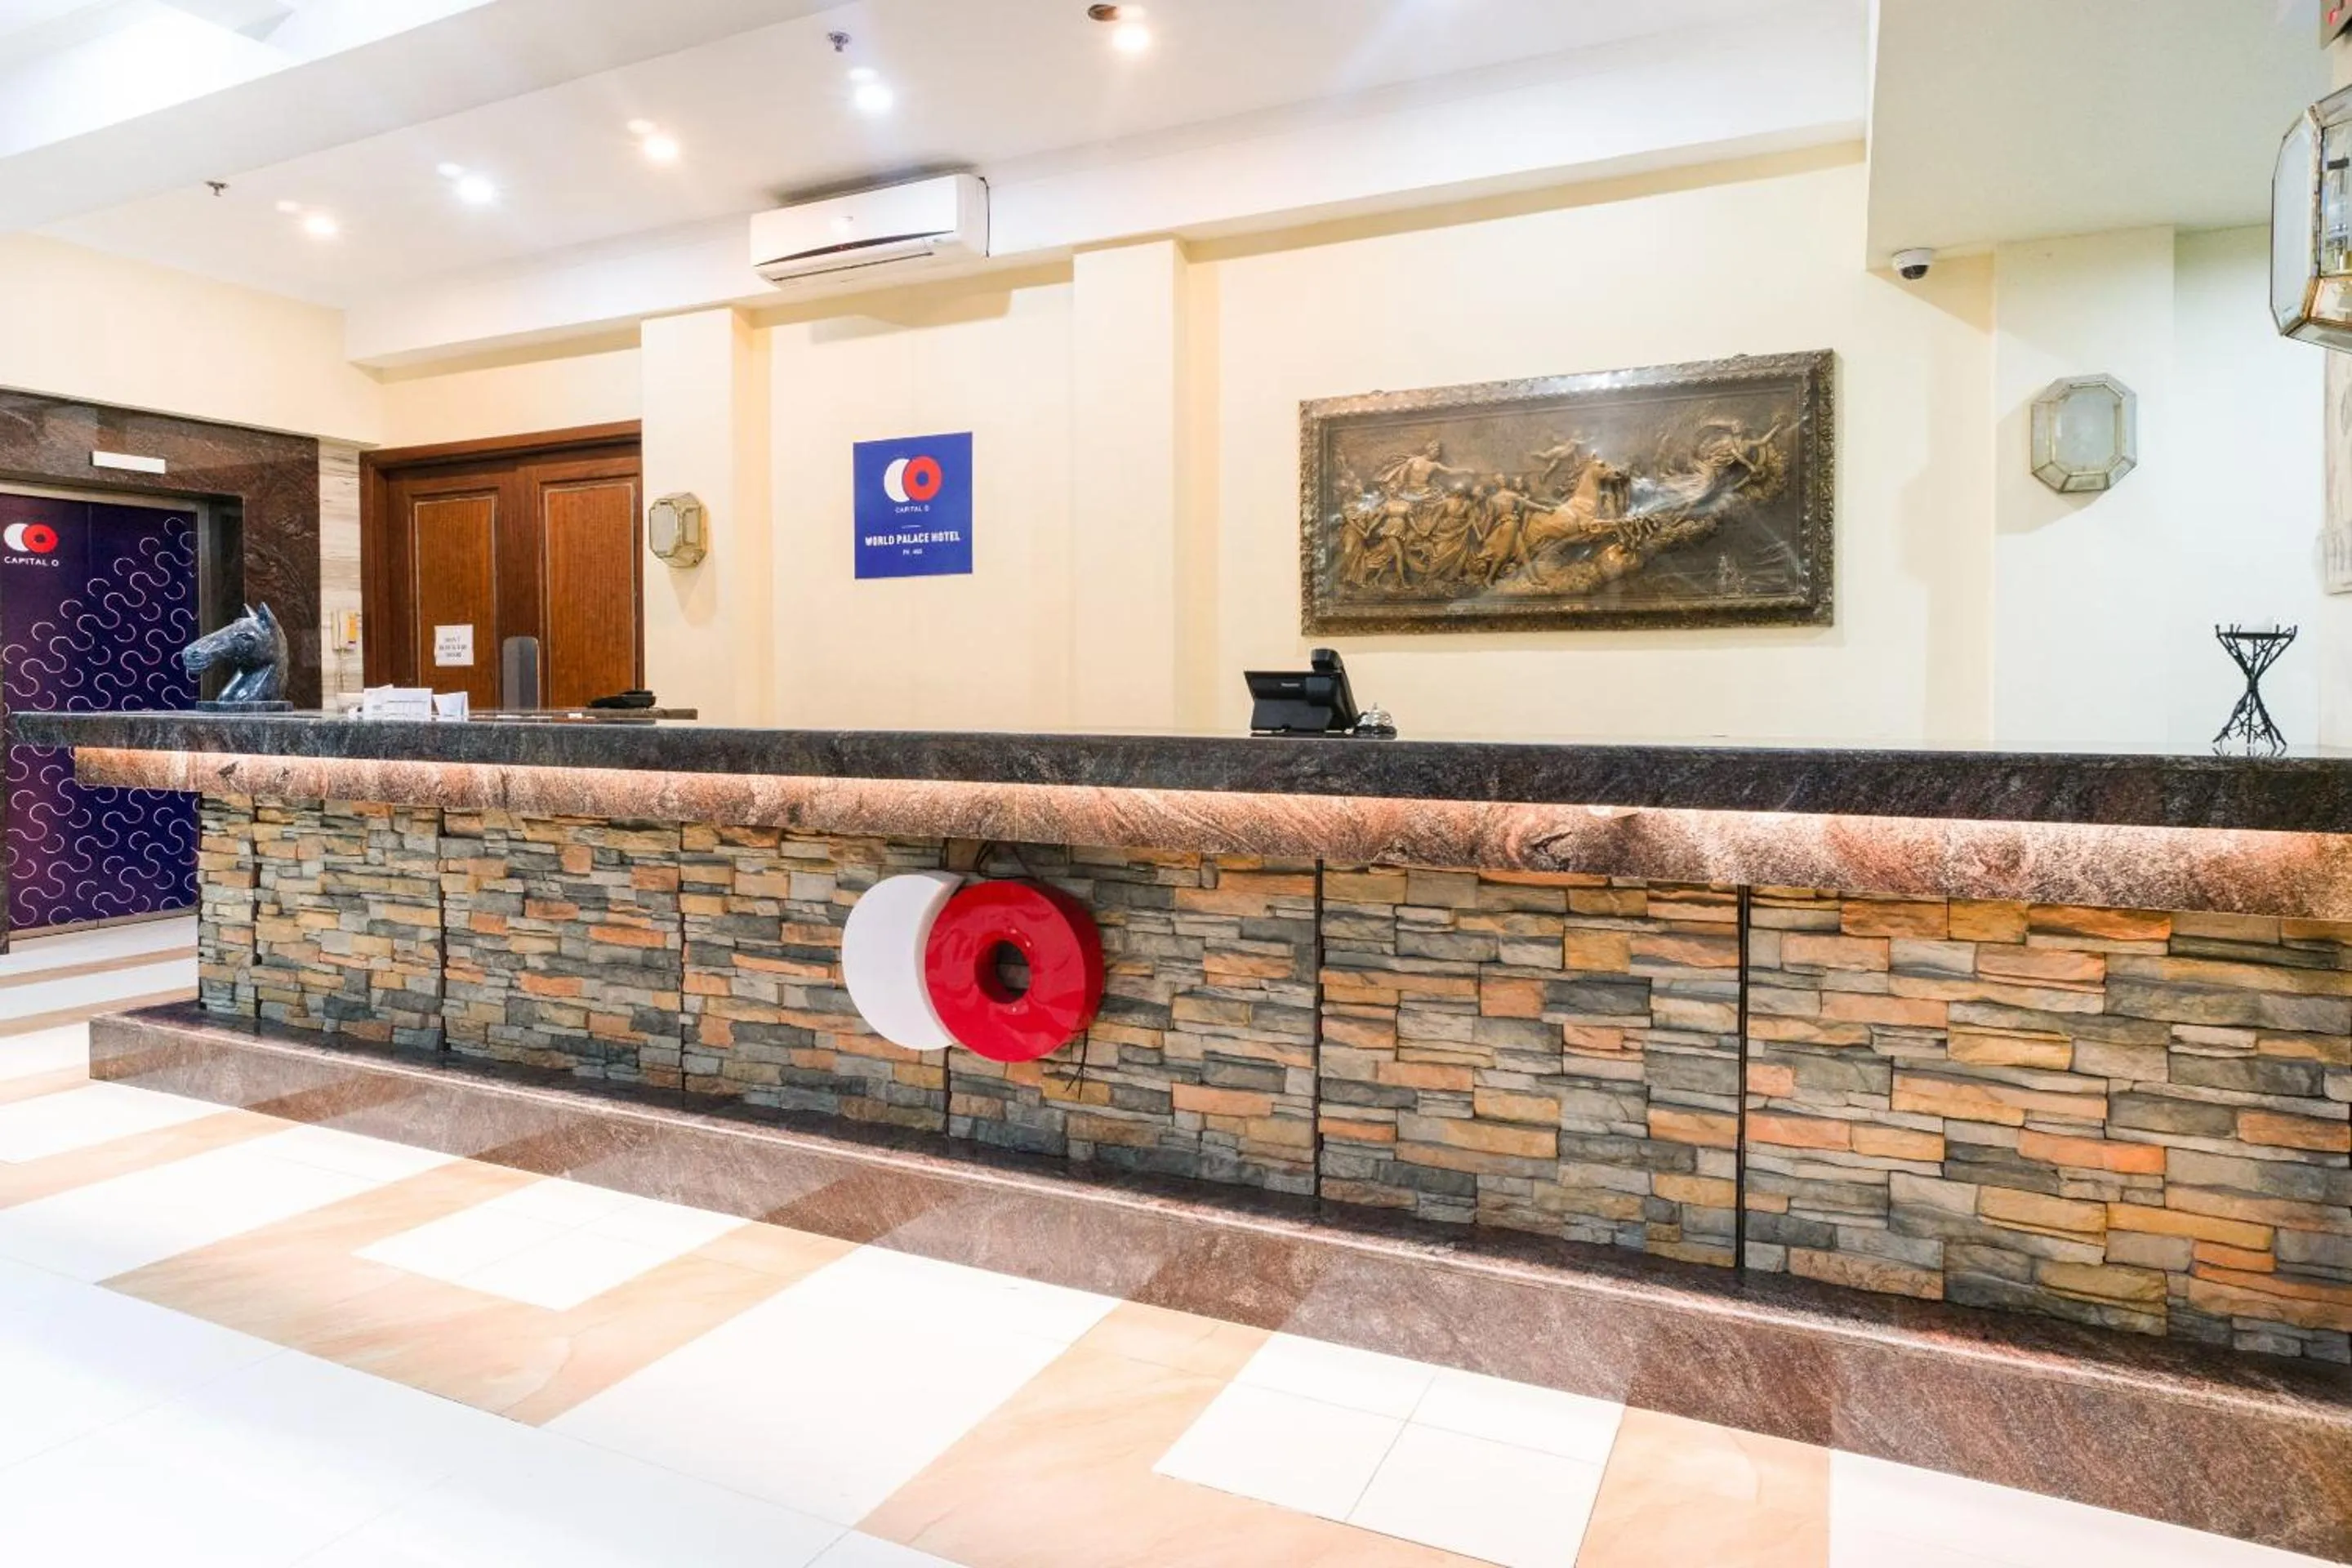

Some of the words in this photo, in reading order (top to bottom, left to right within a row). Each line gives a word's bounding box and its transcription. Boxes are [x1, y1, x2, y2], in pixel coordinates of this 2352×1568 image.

[895, 506, 922, 514] CAPITAL
[865, 534, 895, 546] WORLD
[897, 532, 929, 545] PALACE
[931, 531, 960, 542] HOTEL
[4, 556, 49, 567] CAPITAL
